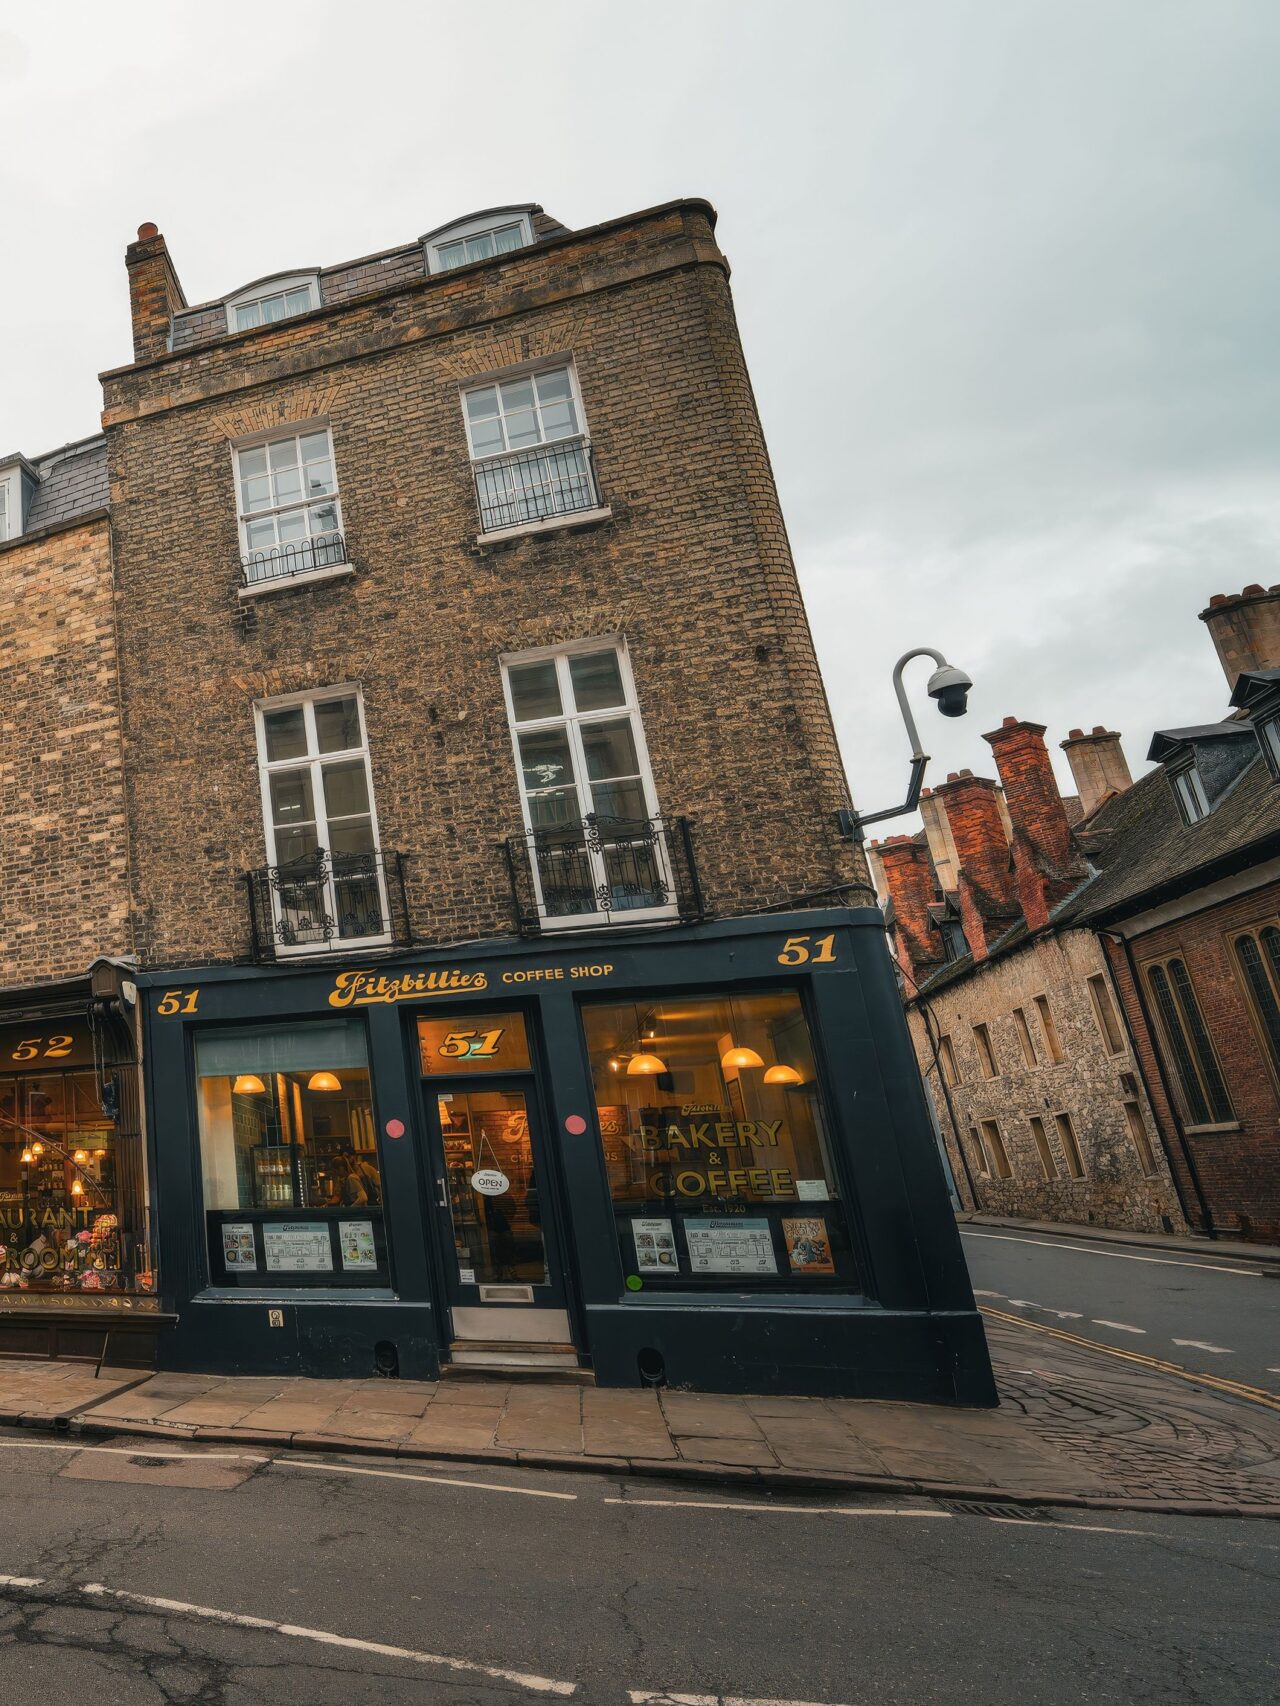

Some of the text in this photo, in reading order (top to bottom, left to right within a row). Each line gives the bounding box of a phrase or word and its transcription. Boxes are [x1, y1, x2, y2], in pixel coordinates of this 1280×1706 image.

[777, 934, 837, 966] 51
[328, 964, 614, 1008] Fitzbillies COFFEE SHOP
[157, 989, 200, 1015] 51
[11, 1035, 73, 1061] 52
[438, 1029, 506, 1057] 51
[640, 1120, 783, 1150] BAKERY
[709, 1152, 722, 1165] &
[478, 1178, 503, 1188] OPEN
[649, 1168, 796, 1198] COFFEE
[9, 1232, 18, 1243] &
[6, 1247, 80, 1270] ROOM
